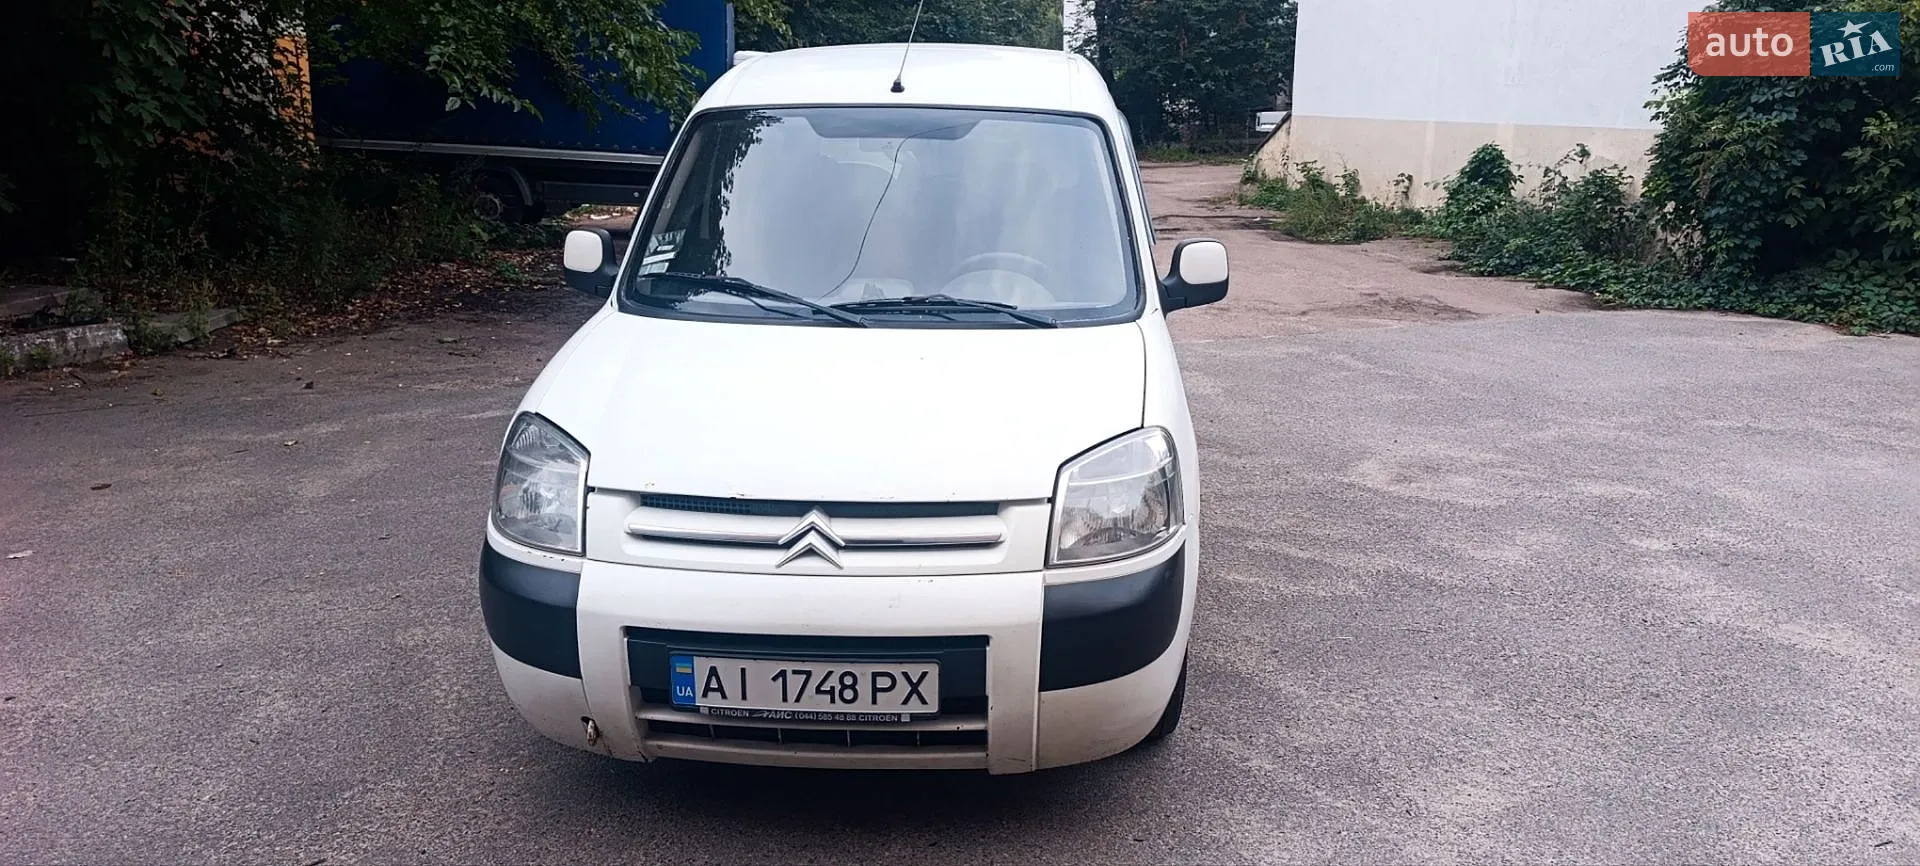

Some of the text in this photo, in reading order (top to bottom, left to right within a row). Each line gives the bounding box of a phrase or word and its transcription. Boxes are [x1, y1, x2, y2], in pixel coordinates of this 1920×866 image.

[701, 665, 929, 705] AI 1748 PX
[676, 686, 693, 697] UA
[794, 712, 817, 720] (044)
